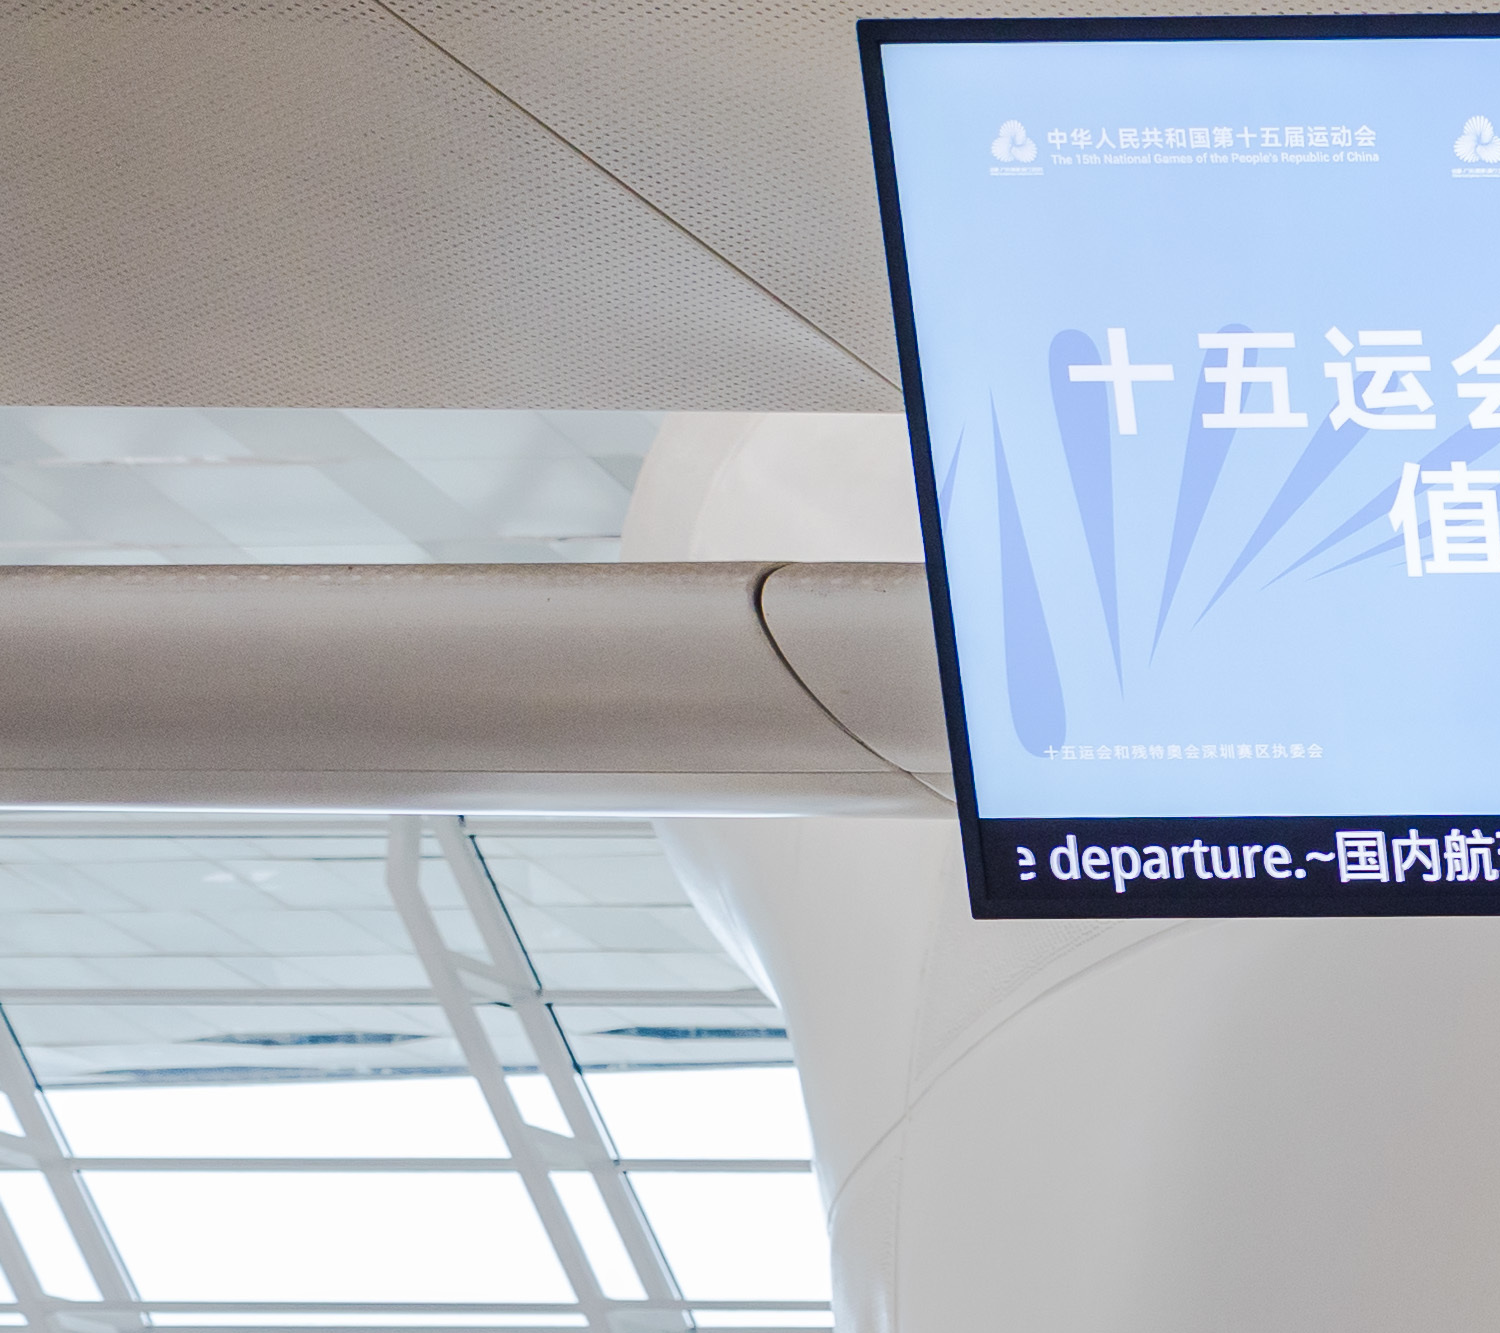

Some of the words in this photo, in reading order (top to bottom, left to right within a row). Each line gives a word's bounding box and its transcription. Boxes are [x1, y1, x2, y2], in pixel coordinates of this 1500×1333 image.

[1048, 125, 1376, 150] 中华人民共和国第十五届运动会
[1050, 153, 1073, 165] The
[1075, 153, 1102, 165] 15th
[1103, 153, 1152, 165] National
[1153, 153, 1194, 164] Games
[1195, 152, 1208, 164] of
[1209, 152, 1229, 164] the
[1231, 152, 1278, 164] People's
[1281, 152, 1330, 164] Republic
[1331, 150, 1345, 163] of
[1346, 151, 1380, 163] China
[1045, 744, 1323, 760] 十五运会和残特奥会深圳赛区执委会
